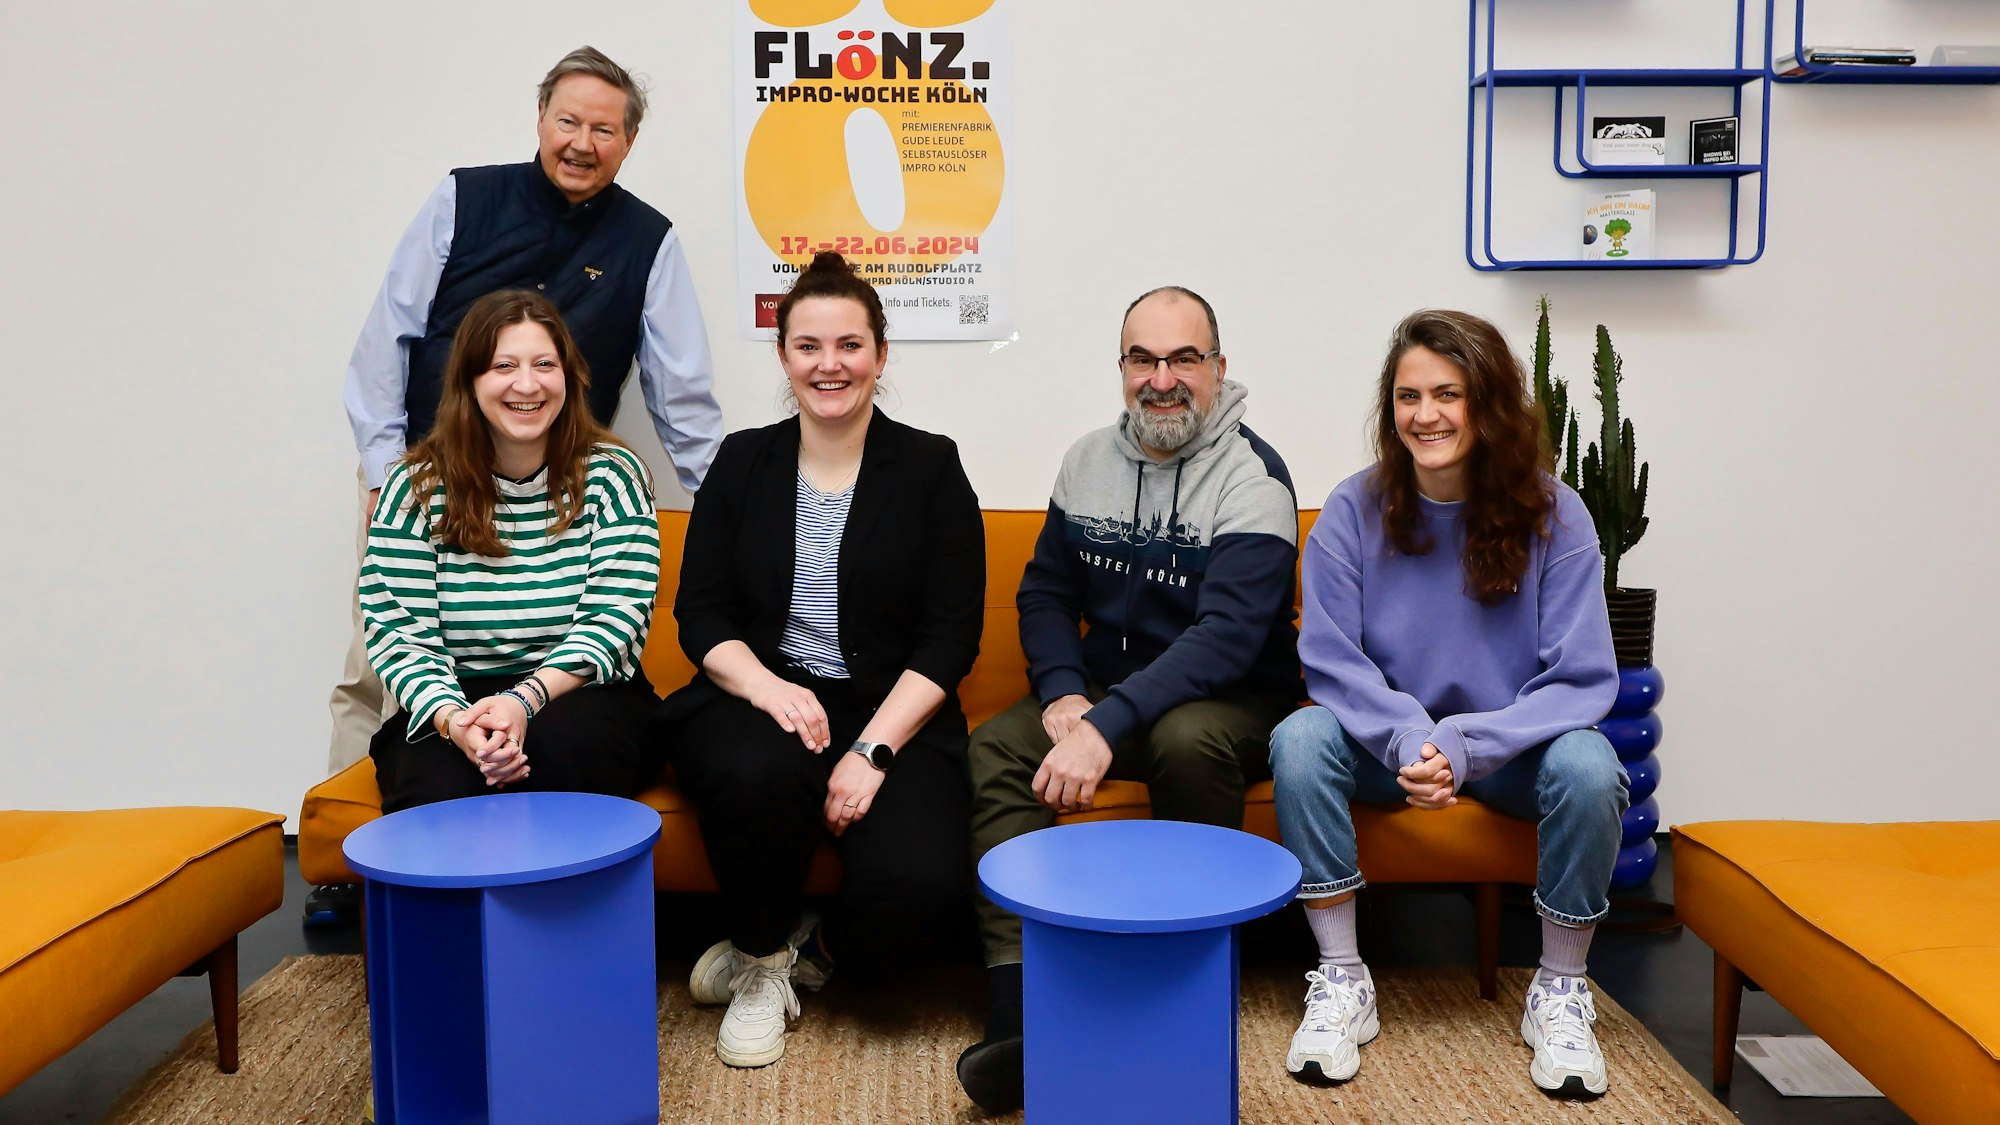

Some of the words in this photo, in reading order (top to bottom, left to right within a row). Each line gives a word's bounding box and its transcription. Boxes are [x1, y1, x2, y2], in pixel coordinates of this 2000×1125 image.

[756, 86, 920, 103] IMPRO-WOCHE
[926, 82, 987, 103] KÖLN
[902, 109, 920, 118] mit:
[902, 122, 992, 132] PREMIERENFABRIK
[902, 136, 930, 146] GUDE
[933, 136, 965, 146] LEUDE
[902, 147, 988, 159] SELBSTAUSLÖSER
[902, 163, 936, 173] IMPRO
[939, 161, 966, 173] KÖLN
[865, 263, 884, 273] AM
[887, 263, 983, 273] RUDOLFPLATZ
[780, 277, 788, 286] in
[864, 276, 893, 285] MPRO
[894, 275, 966, 286] KÖLN/STUDIO
[967, 277, 975, 285] A
[885, 297, 901, 308] Info
[903, 297, 919, 308] und
[921, 297, 954, 308] Tickets:
[1146, 568, 1188, 589] KÖLN
